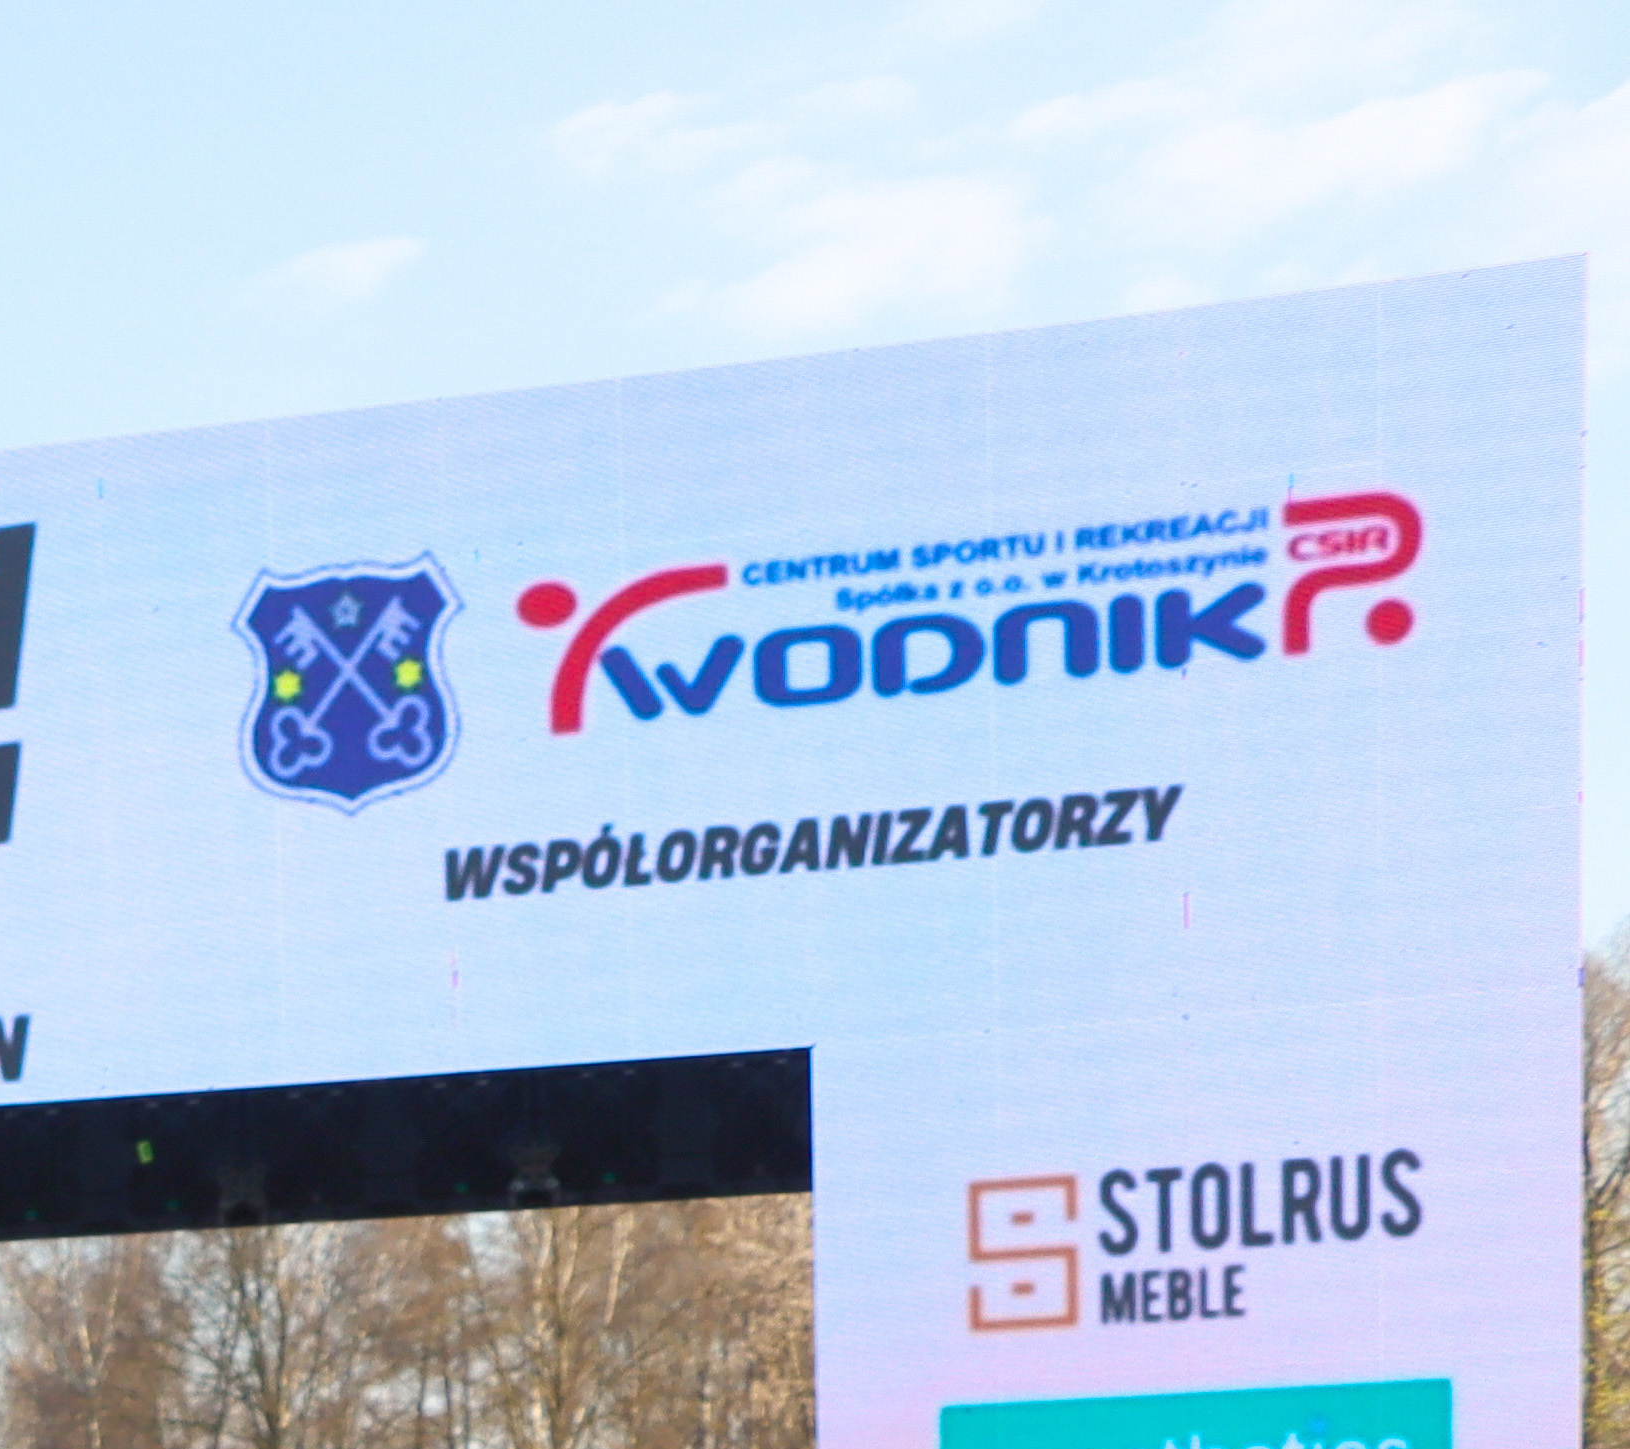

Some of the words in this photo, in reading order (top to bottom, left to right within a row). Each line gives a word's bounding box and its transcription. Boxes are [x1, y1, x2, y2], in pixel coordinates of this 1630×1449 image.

[742, 548, 900, 587] CENTRUM
[911, 532, 1046, 568] SPORTU
[1056, 529, 1064, 553] I
[1075, 506, 1270, 552] REKREACJI
[1077, 544, 1269, 588] Krotoszynie
[442, 785, 1183, 902] WSPÓŁORGANIZATORZY
[1097, 1148, 1424, 1257] STOLRUS
[1099, 1264, 1247, 1325] MEBLE
